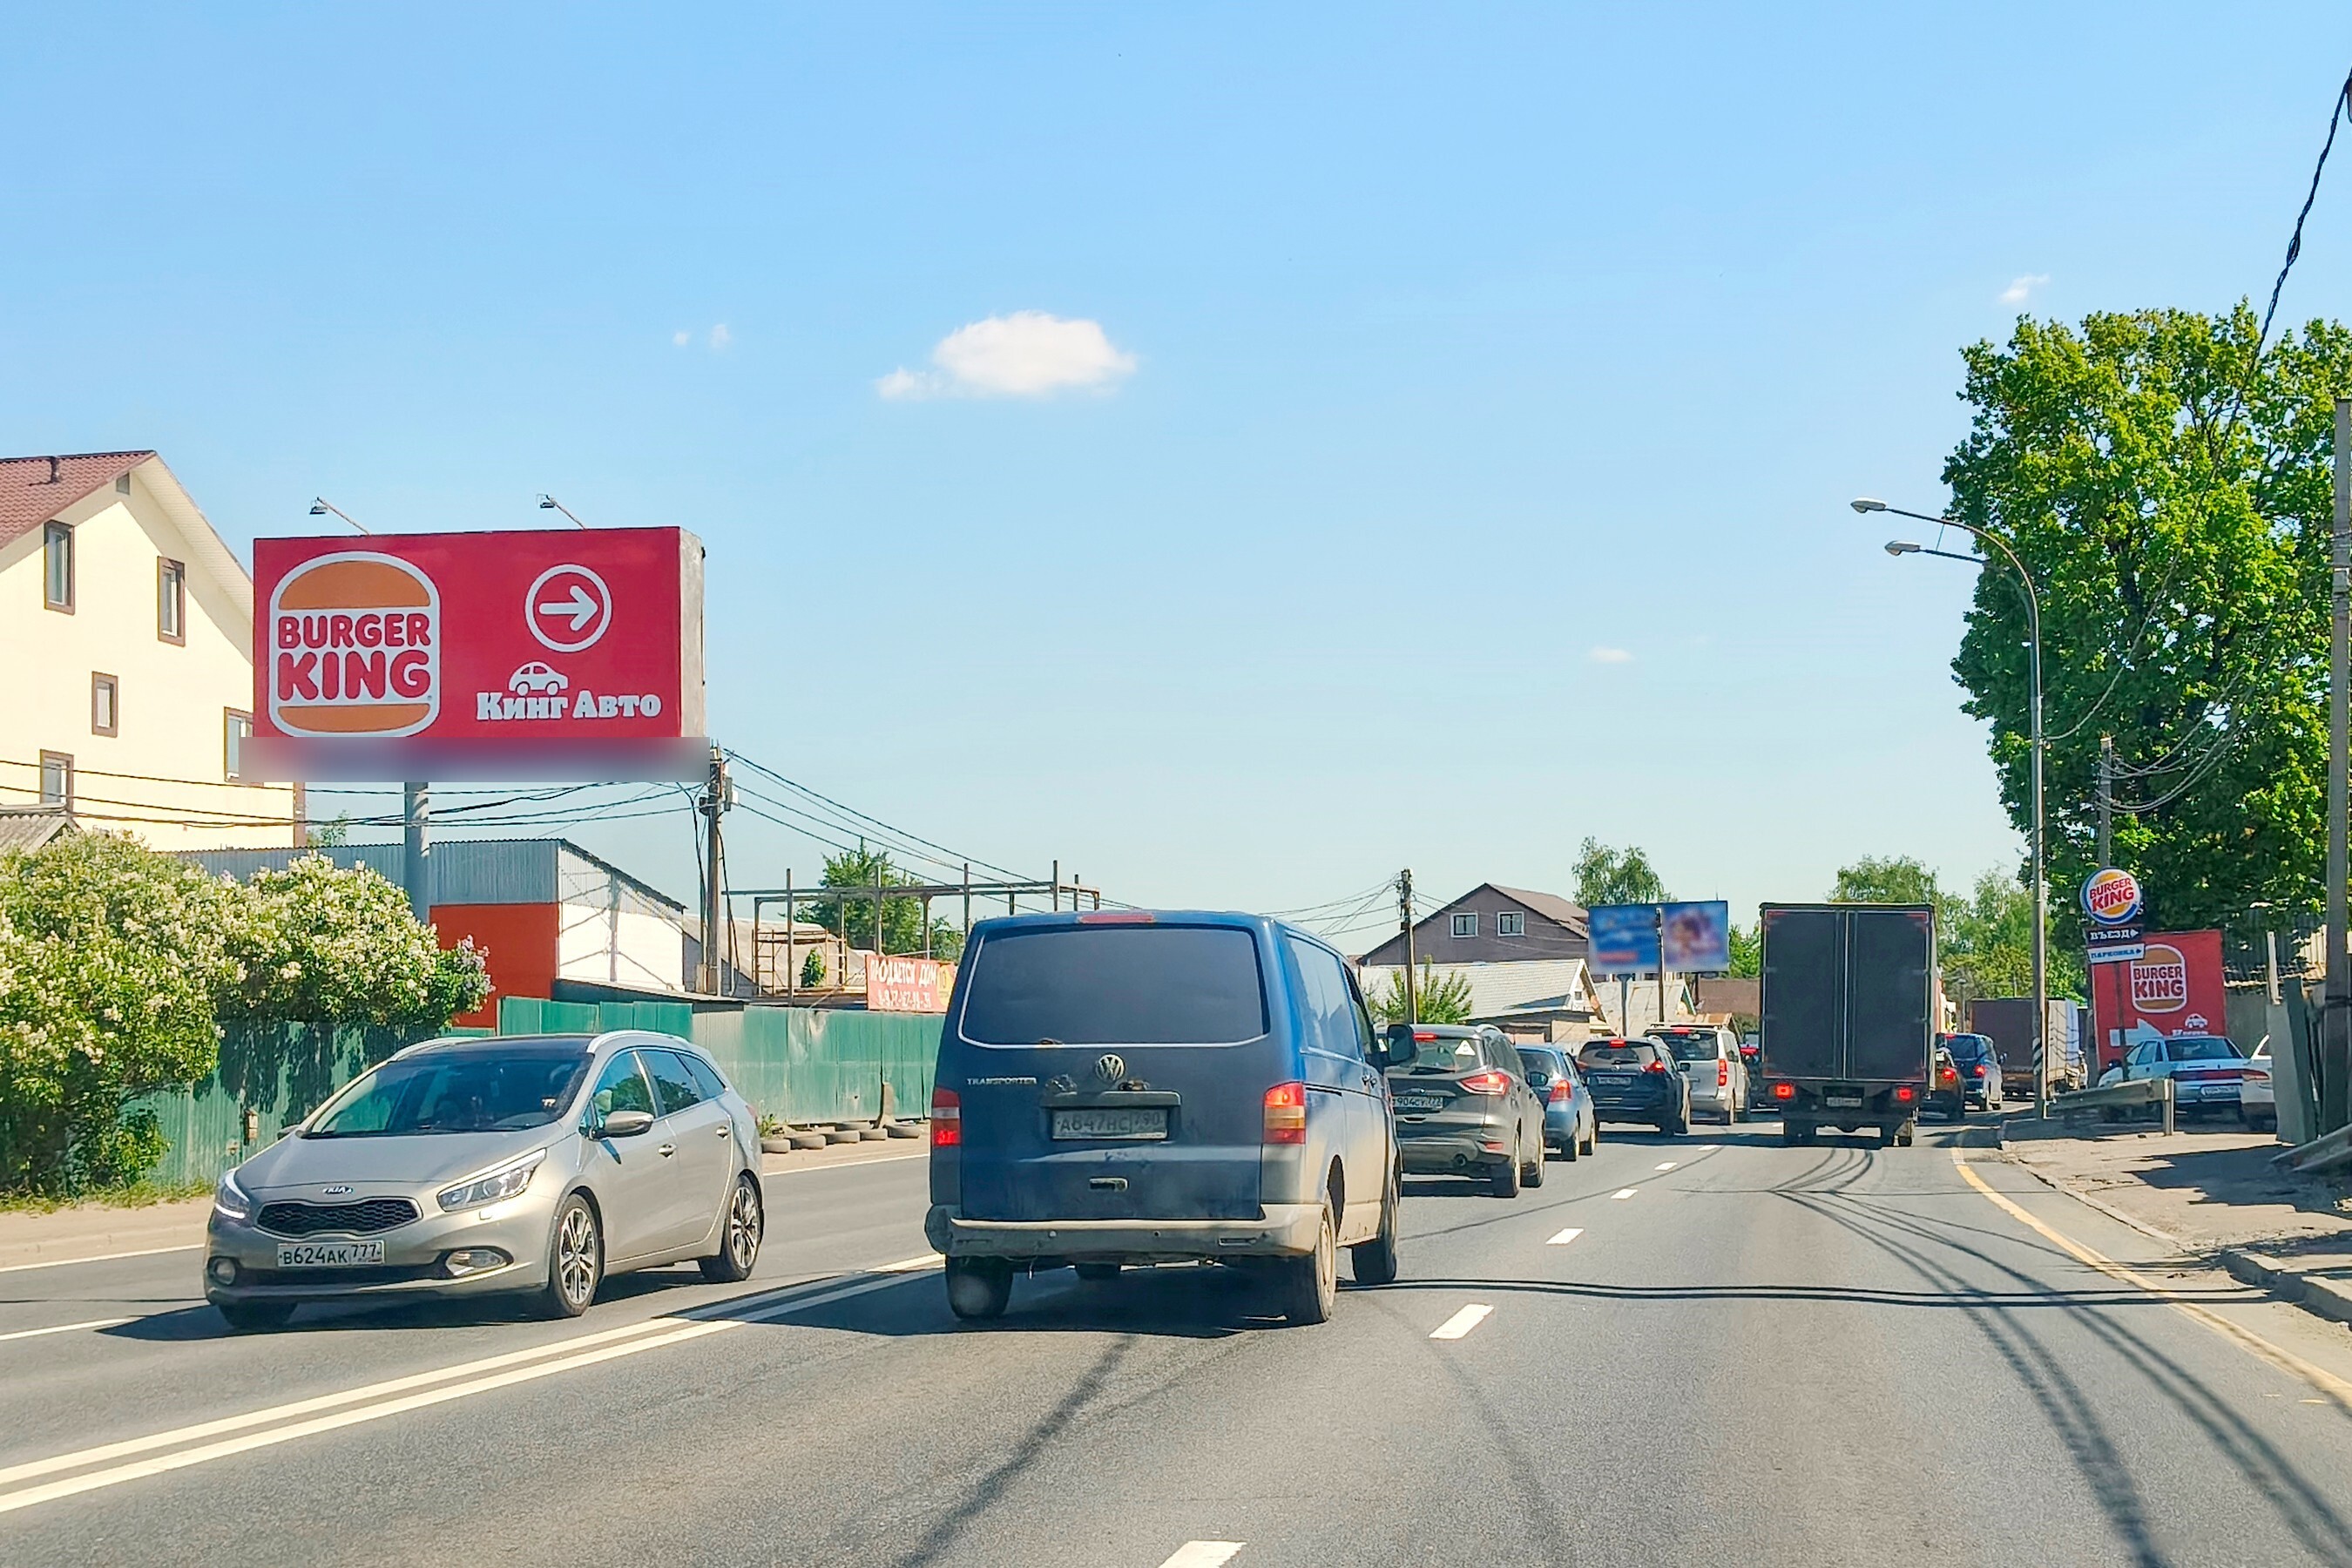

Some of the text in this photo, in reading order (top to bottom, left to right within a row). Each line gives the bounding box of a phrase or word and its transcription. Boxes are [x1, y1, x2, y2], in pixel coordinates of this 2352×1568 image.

[278, 613, 431, 649] BURGER
[278, 650, 431, 700] KING
[476, 689, 662, 720] Кинг Авто
[2090, 877, 2132, 899] BURGER
[2092, 887, 2134, 912] KING
[2090, 929, 2131, 941] ВЪЕЗД
[2133, 966, 2182, 980] BURGER
[2134, 979, 2184, 998] KING
[966, 1077, 1037, 1085] TRANSPORTER
[283, 1247, 348, 1264] В624АК
[351, 1244, 376, 1257] 777
